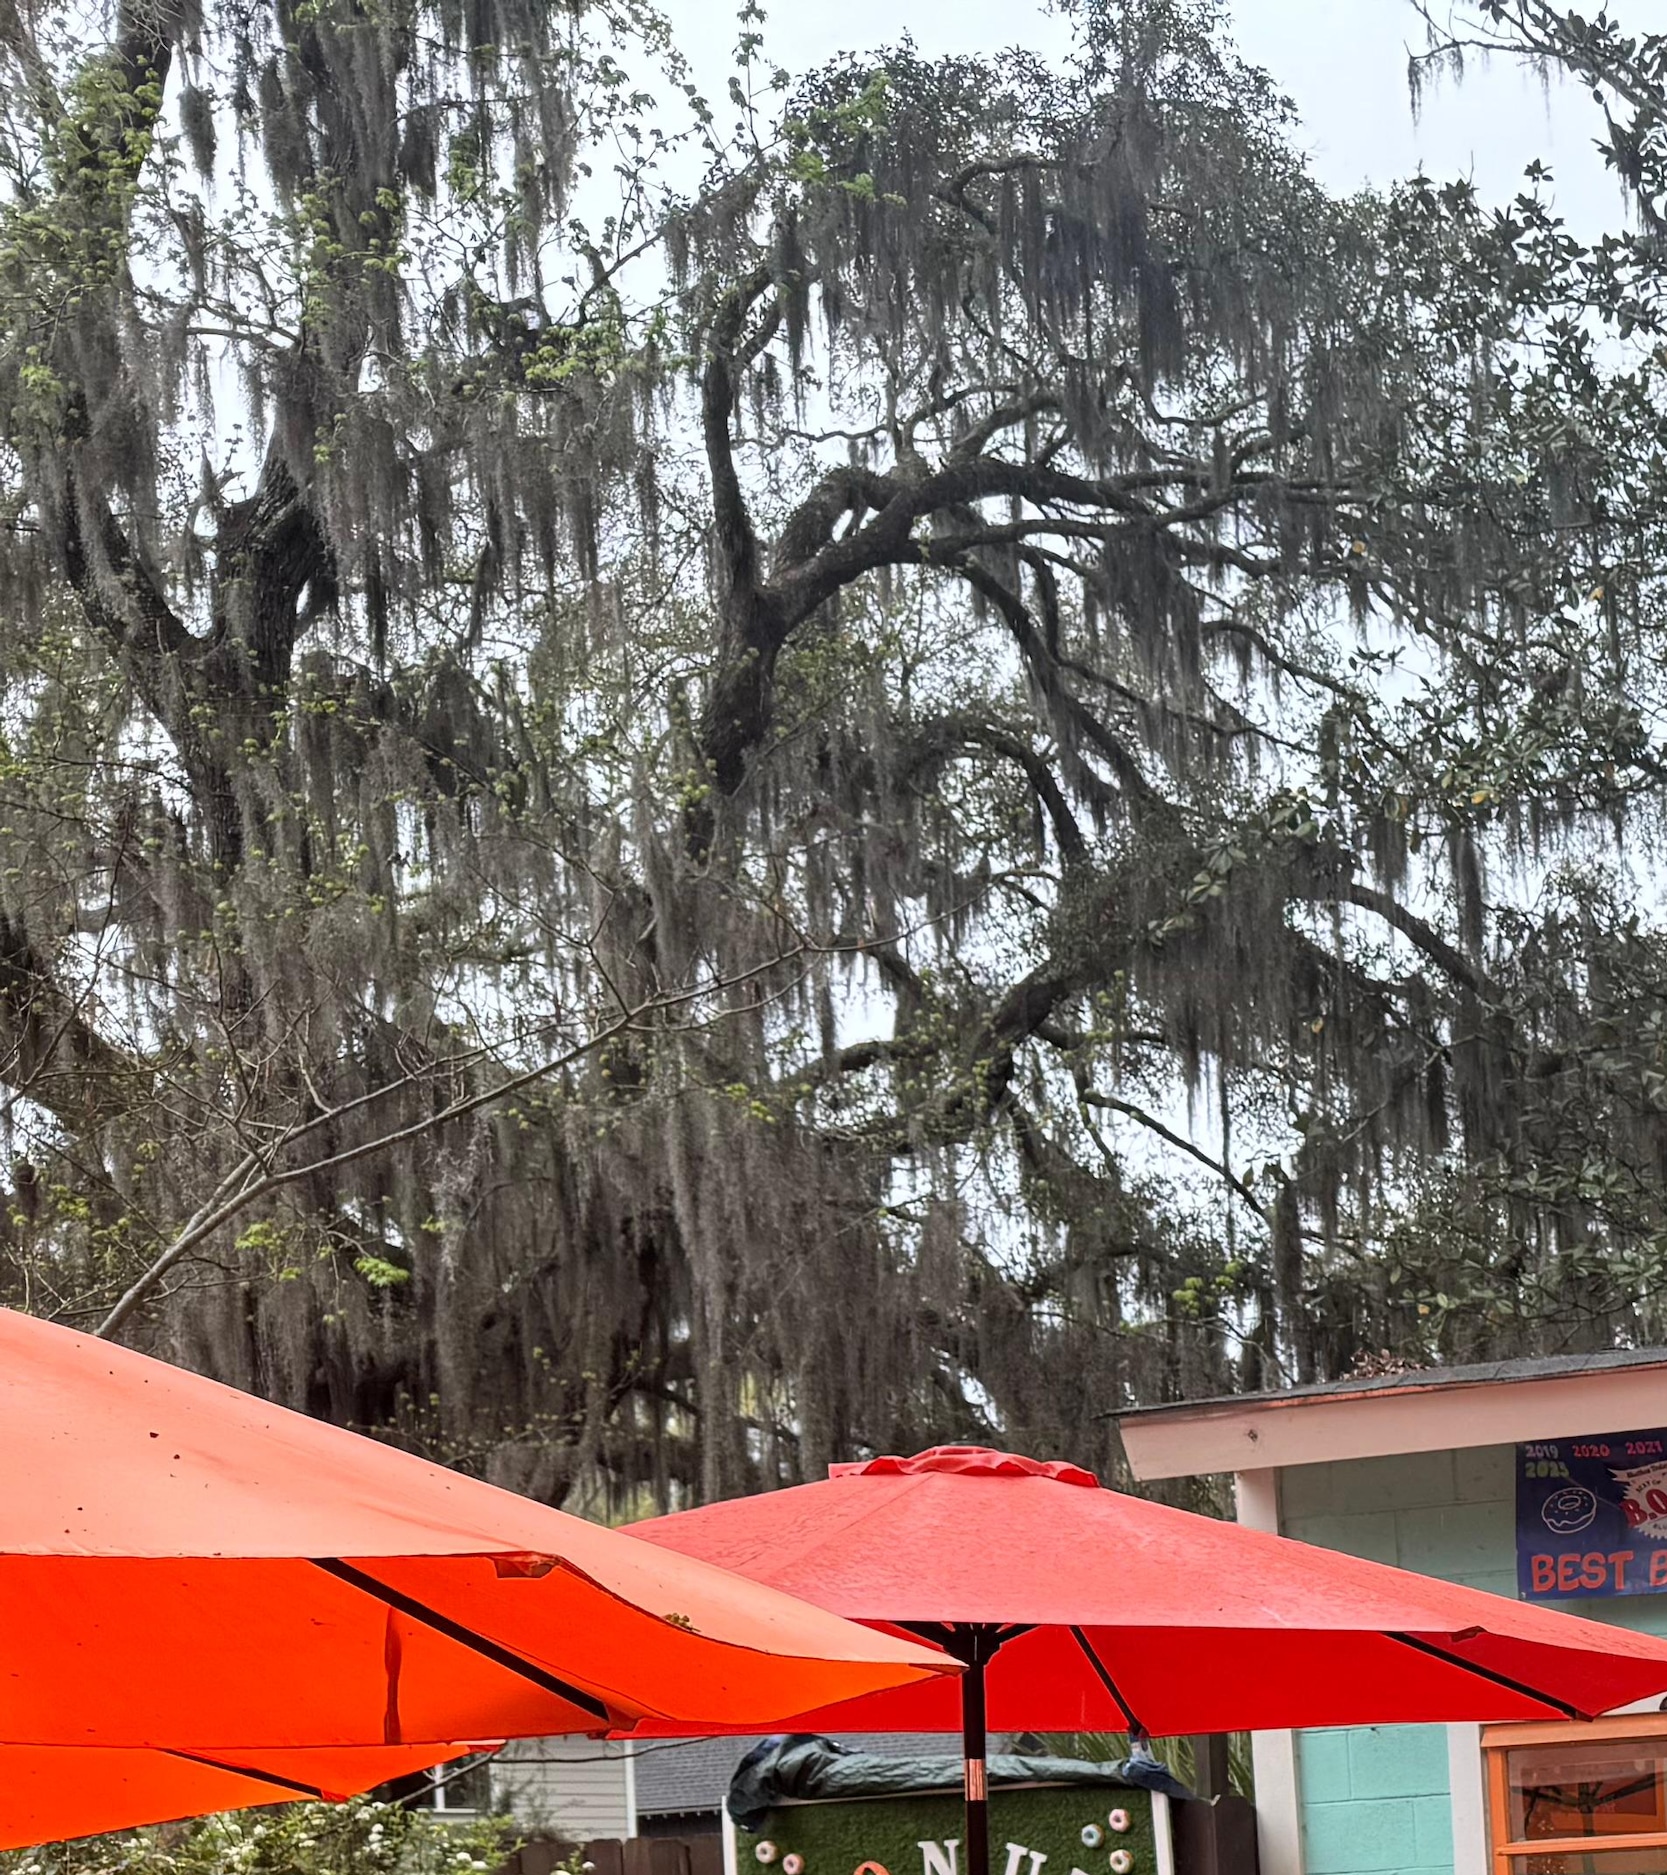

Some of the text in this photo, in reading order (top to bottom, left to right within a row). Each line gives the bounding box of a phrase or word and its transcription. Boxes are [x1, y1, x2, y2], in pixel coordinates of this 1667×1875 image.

[1525, 1445, 1559, 1459] 2019
[1572, 1443, 1610, 1457] 2020
[1625, 1441, 1663, 1455] 2021
[1531, 1551, 1634, 1592] BEST
